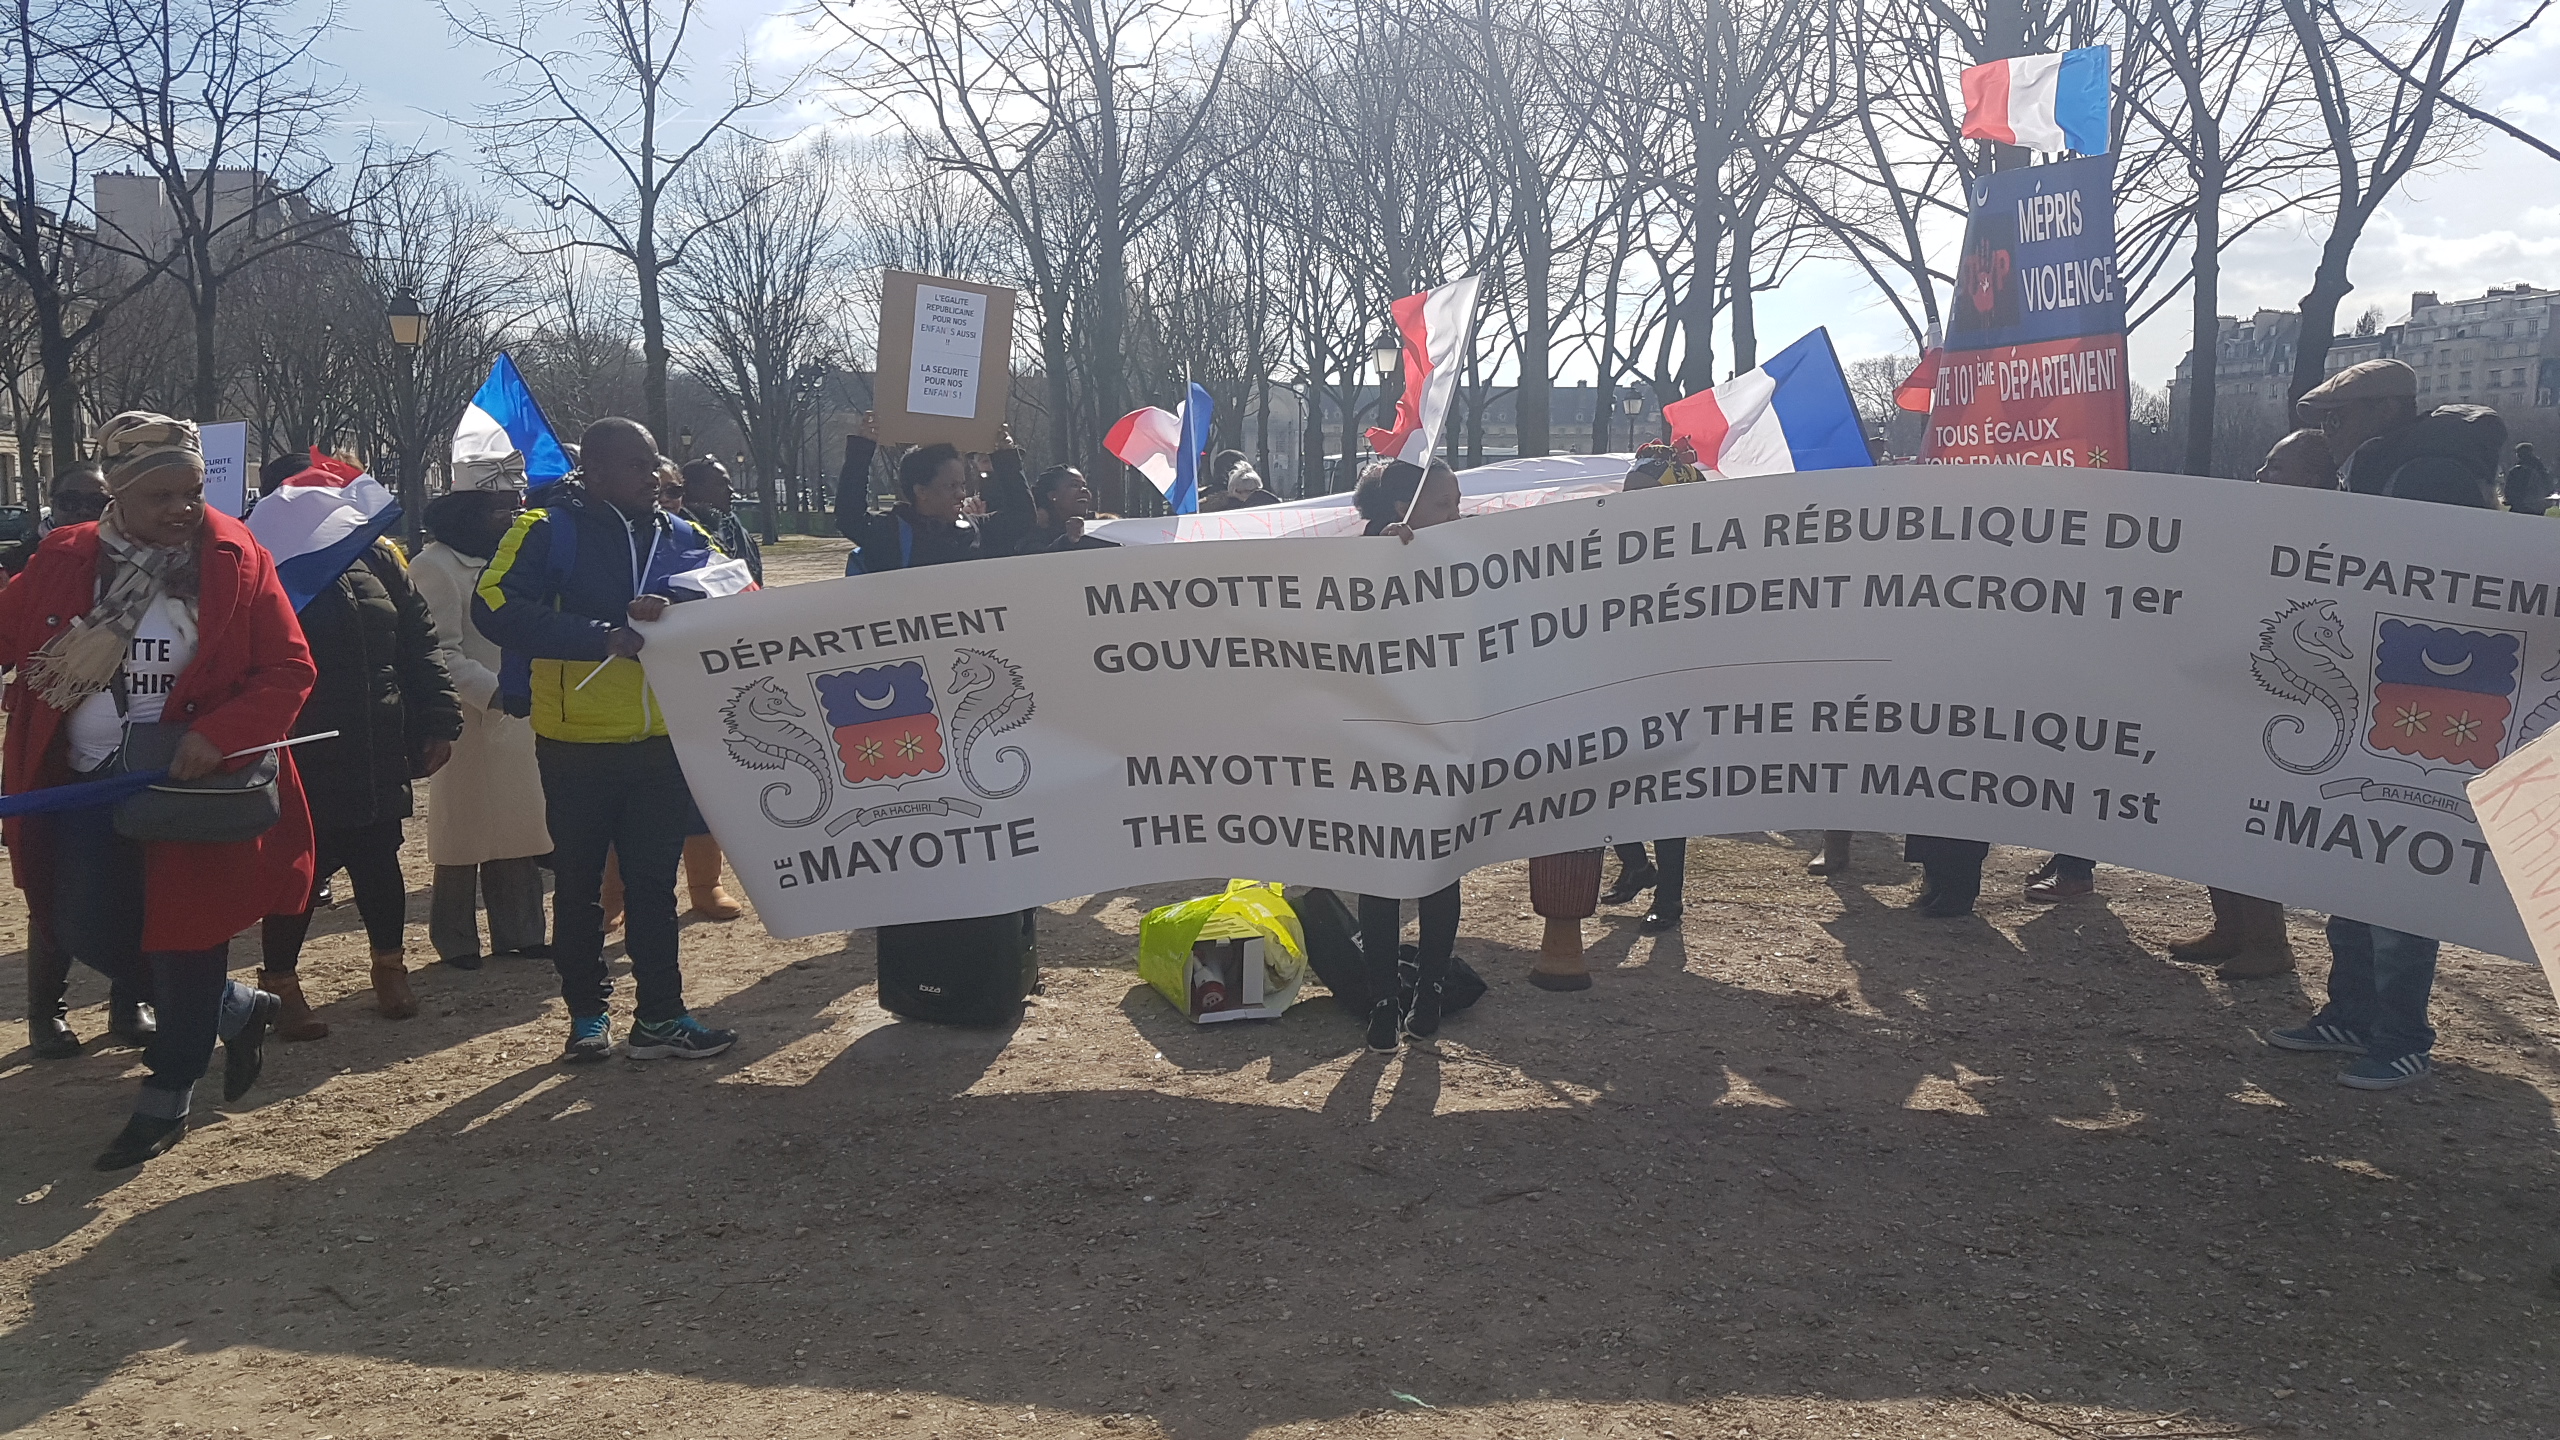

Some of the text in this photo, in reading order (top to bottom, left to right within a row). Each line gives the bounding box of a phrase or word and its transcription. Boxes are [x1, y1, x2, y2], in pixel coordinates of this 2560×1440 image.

[2017, 180, 2083, 243] MÉPRIS
[934, 294, 969, 306] L'EGALITE
[2021, 256, 2114, 312] VIOLENCE
[926, 303, 975, 317] REPUBLICAINE
[932, 314, 967, 327] POUR NOS
[920, 323, 977, 339] ENFANS AUSSI
[920, 363, 969, 378] LA SECURITE
[924, 376, 963, 388] POUR NOS
[1999, 346, 2117, 402] DÉPARTEMENT
[923, 387, 958, 399] ENFANS
[1936, 416, 2060, 447] TOUS ÉGAUX
[1085, 503, 2182, 616] MAYOTTE ABANDONNÉ DE LA RÉBUBLIQUE DU
[2270, 543, 2560, 618] DÉPARTEM
[699, 606, 1008, 675] DÉPARTEMENT
[1093, 574, 2183, 675] GOUVERNEMENT ET DU PRÉSIDENT MACRON 1er
[1126, 694, 2156, 797] MAYOTTE ABANDONED BY THE RÉBUBLIQUE,
[872, 803, 932, 819] RA HACHIRI
[1122, 763, 2161, 861] THE GOVERNMENT AND PRESIDENT MACRON 1st
[2245, 797, 2270, 836] DE
[2381, 786, 2460, 812] RA HACHIRI
[774, 817, 1040, 889] DE MAYOTTE
